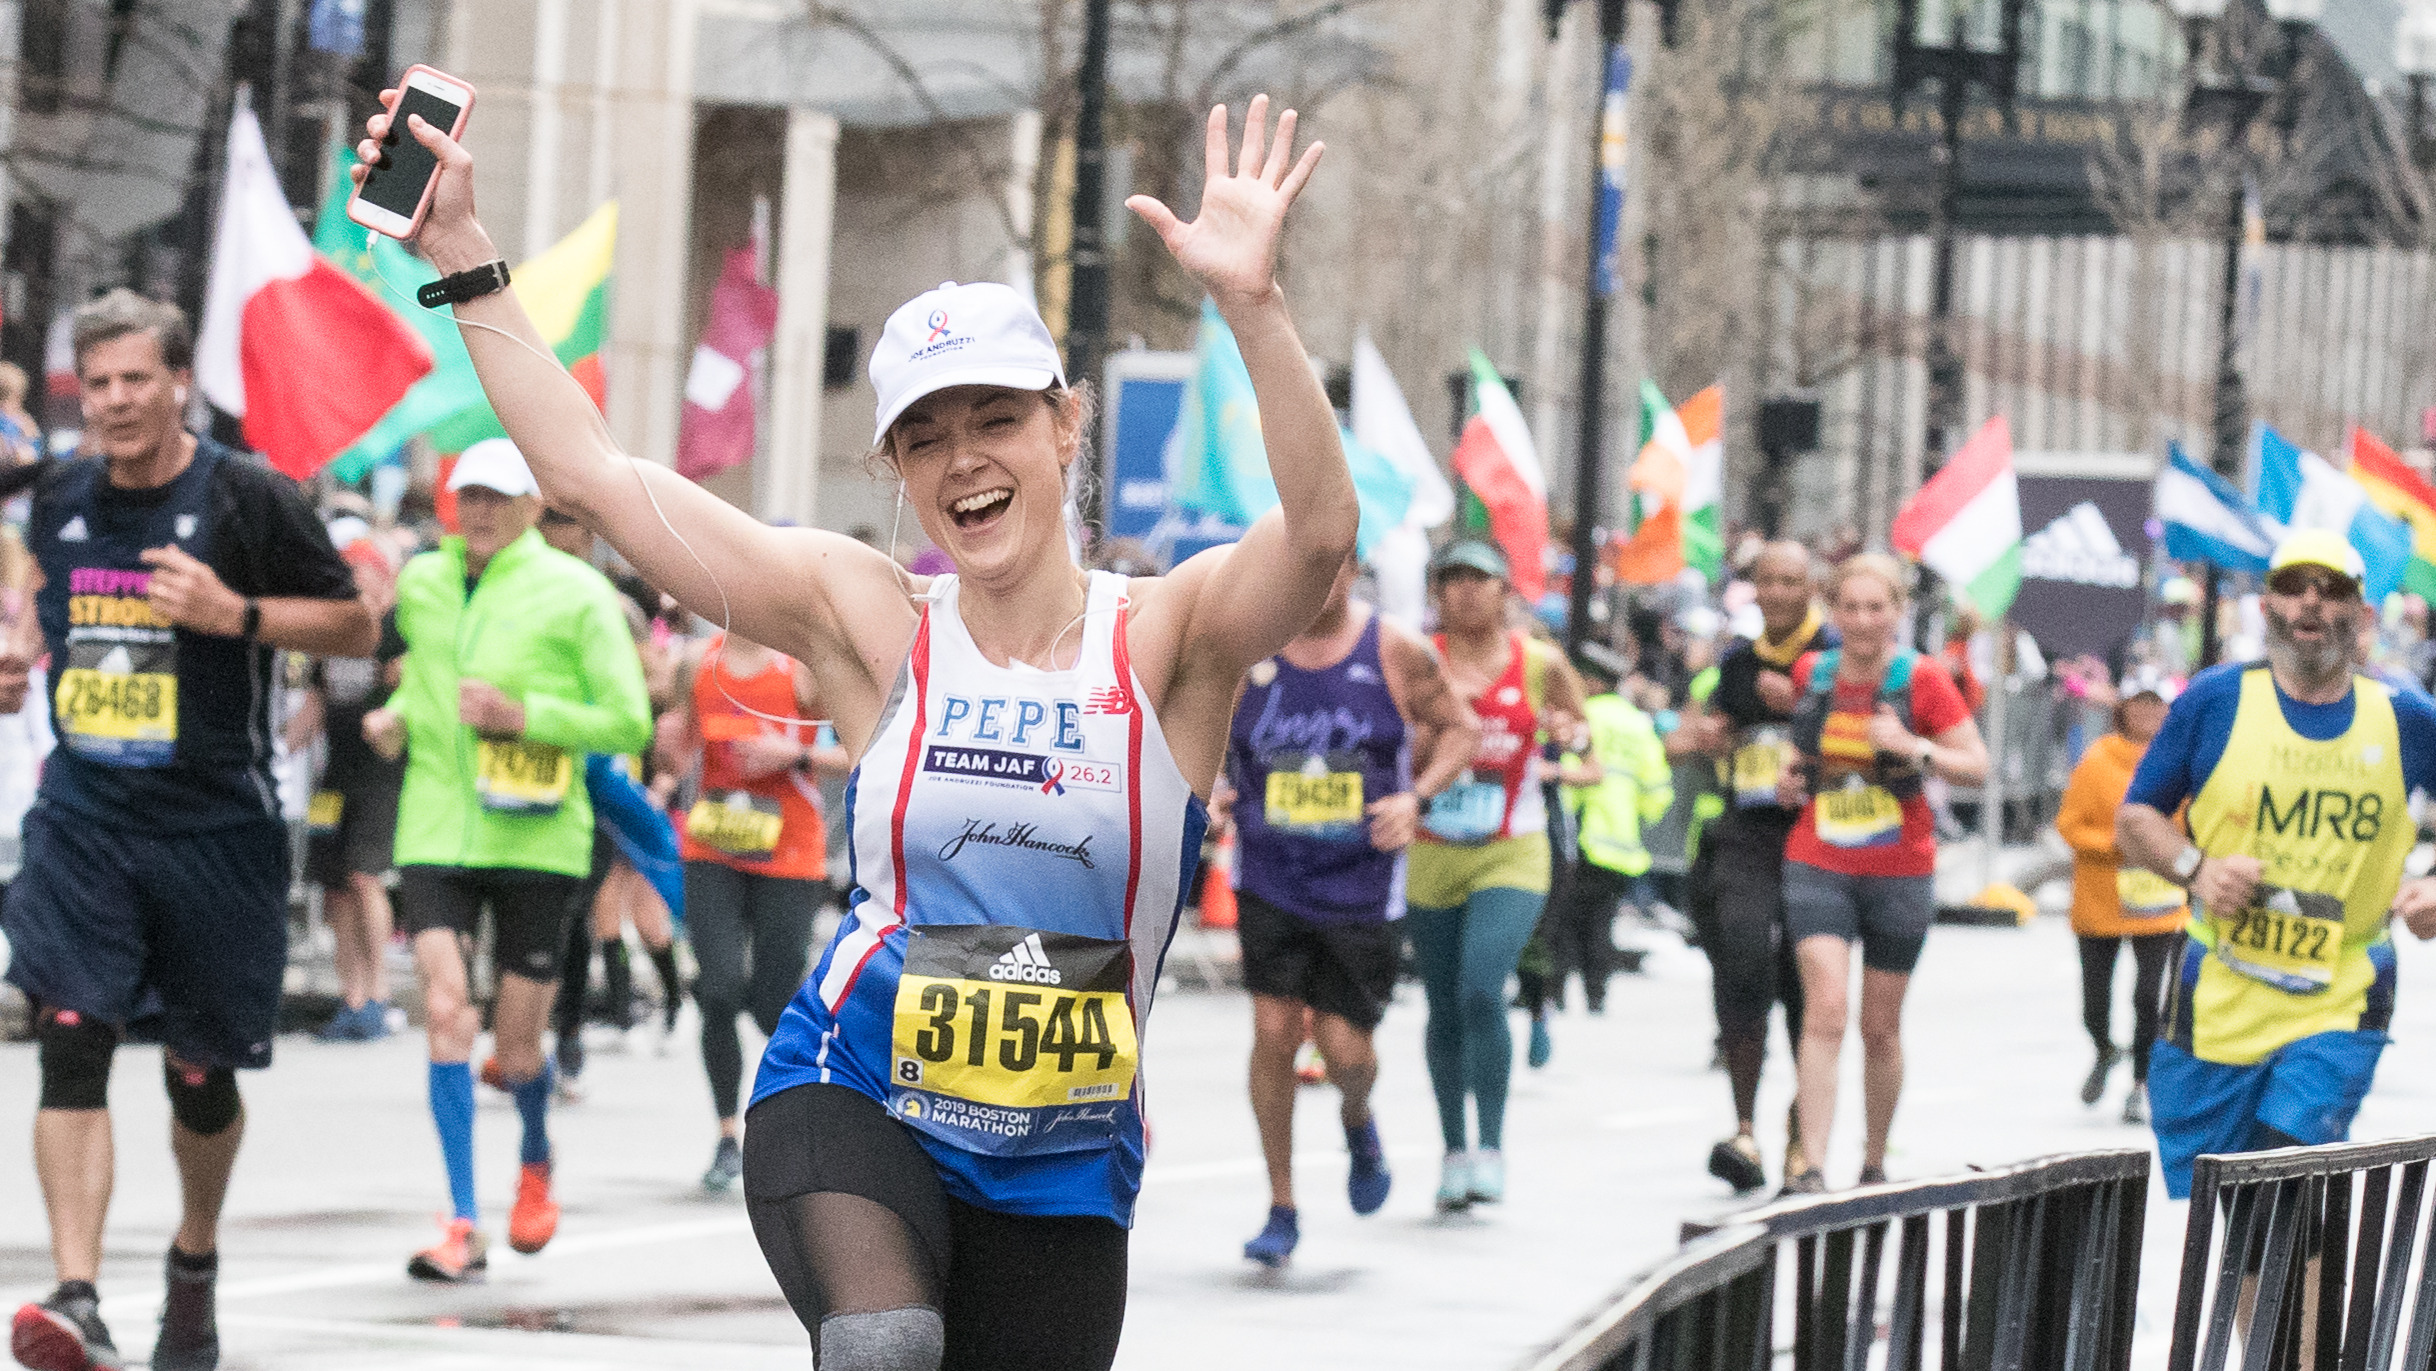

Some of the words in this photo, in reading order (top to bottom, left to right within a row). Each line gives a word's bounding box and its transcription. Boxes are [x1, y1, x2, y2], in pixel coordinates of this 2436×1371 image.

[908, 348, 924, 363] JOE
[927, 336, 975, 354] ANDRUZZI
[934, 692, 1087, 755] PEPE
[928, 775, 942, 783] JOE
[944, 776, 983, 787] ANDRUZZI
[984, 780, 1035, 792] FOUNDATION
[934, 751, 990, 772] TEAM
[993, 756, 1036, 776] JAF
[1070, 765, 1112, 785] 26.2
[2256, 783, 2385, 842] MR8
[938, 817, 1002, 862] John
[1000, 821, 1096, 870] Hancock
[2230, 906, 2330, 963] 29122
[988, 961, 1063, 985] adidas
[915, 983, 1118, 1074] 31544
[899, 1060, 921, 1083] 8
[931, 1113, 1033, 1137] MARATHON
[934, 1097, 967, 1114] 2019
[968, 1102, 1032, 1125] BOSTON
